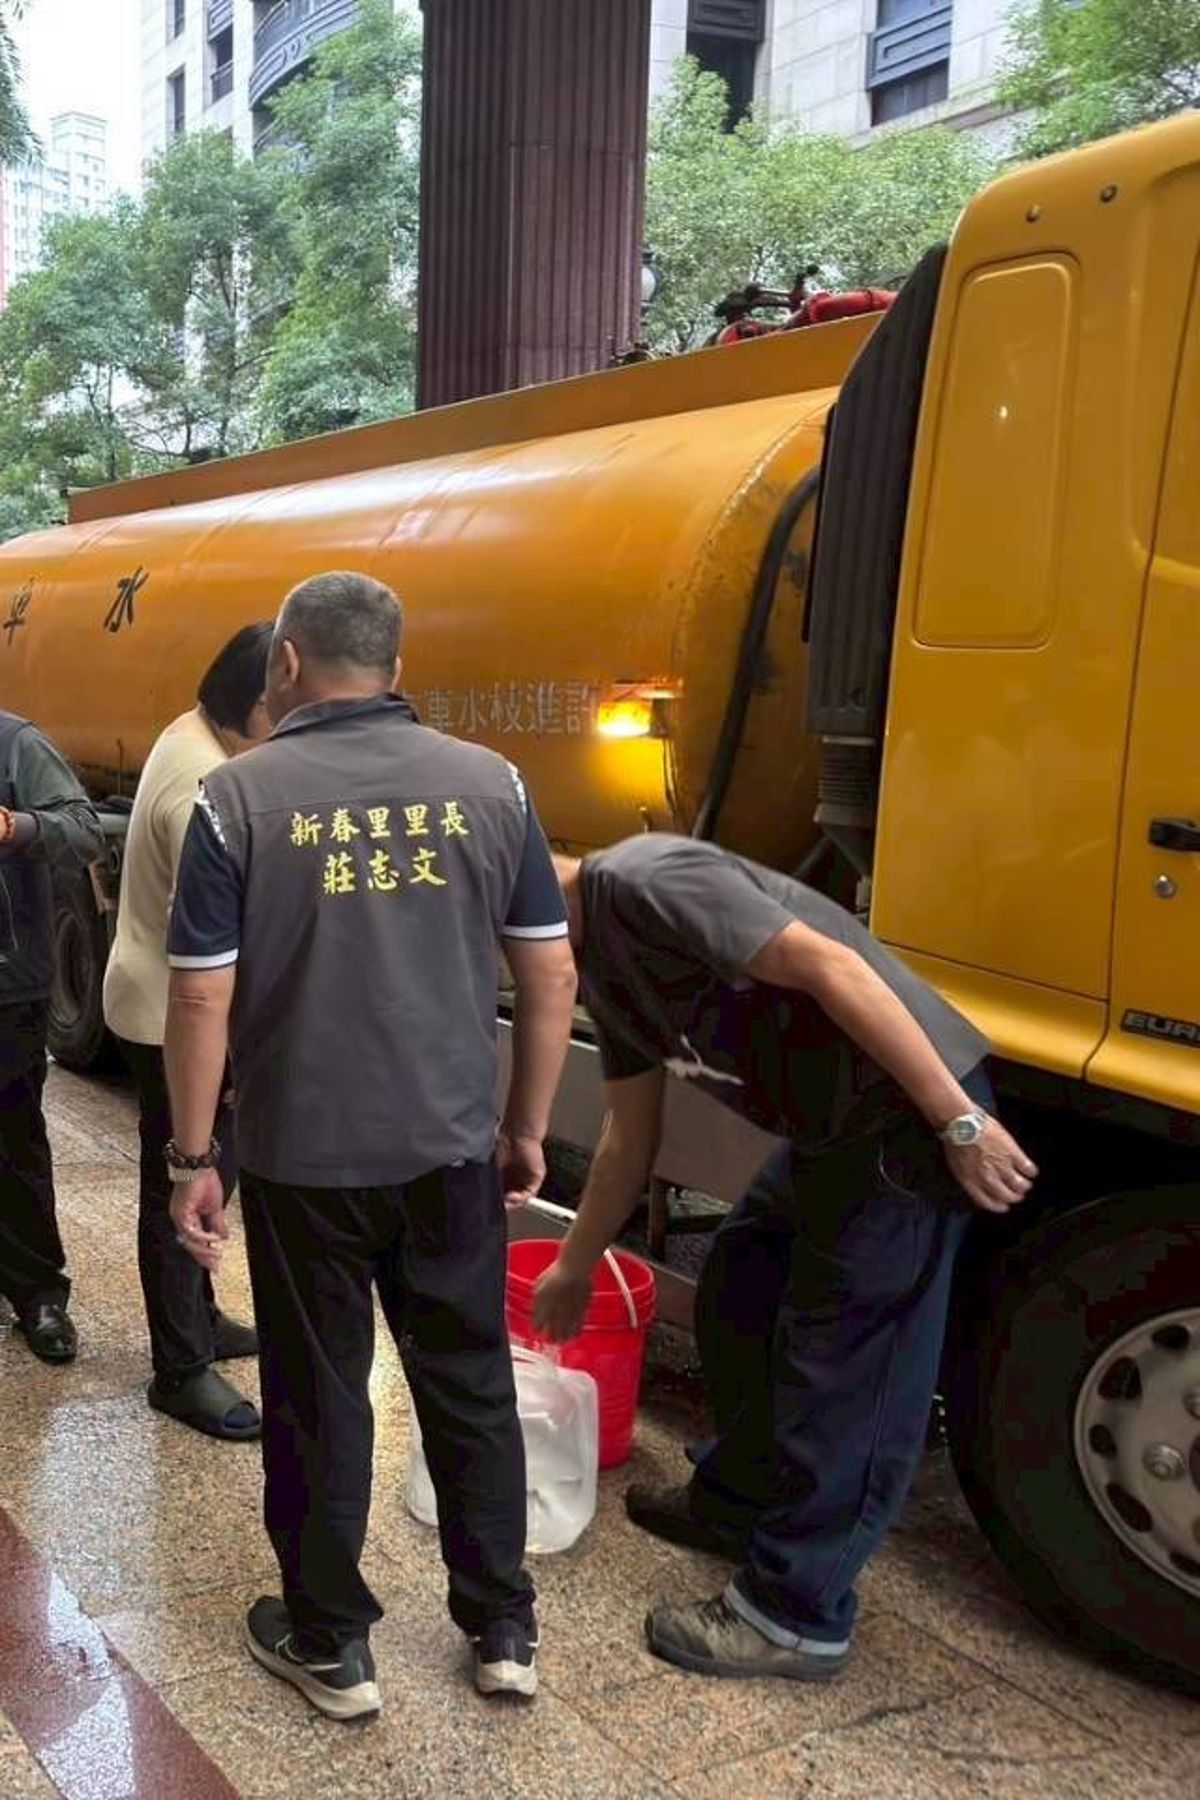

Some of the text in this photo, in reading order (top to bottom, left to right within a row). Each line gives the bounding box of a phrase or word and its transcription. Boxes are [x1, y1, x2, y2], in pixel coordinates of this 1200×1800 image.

[290, 801, 469, 846] 新春里里長
[323, 847, 448, 894] 莊志文
[1124, 1012, 1200, 1041] EUR
